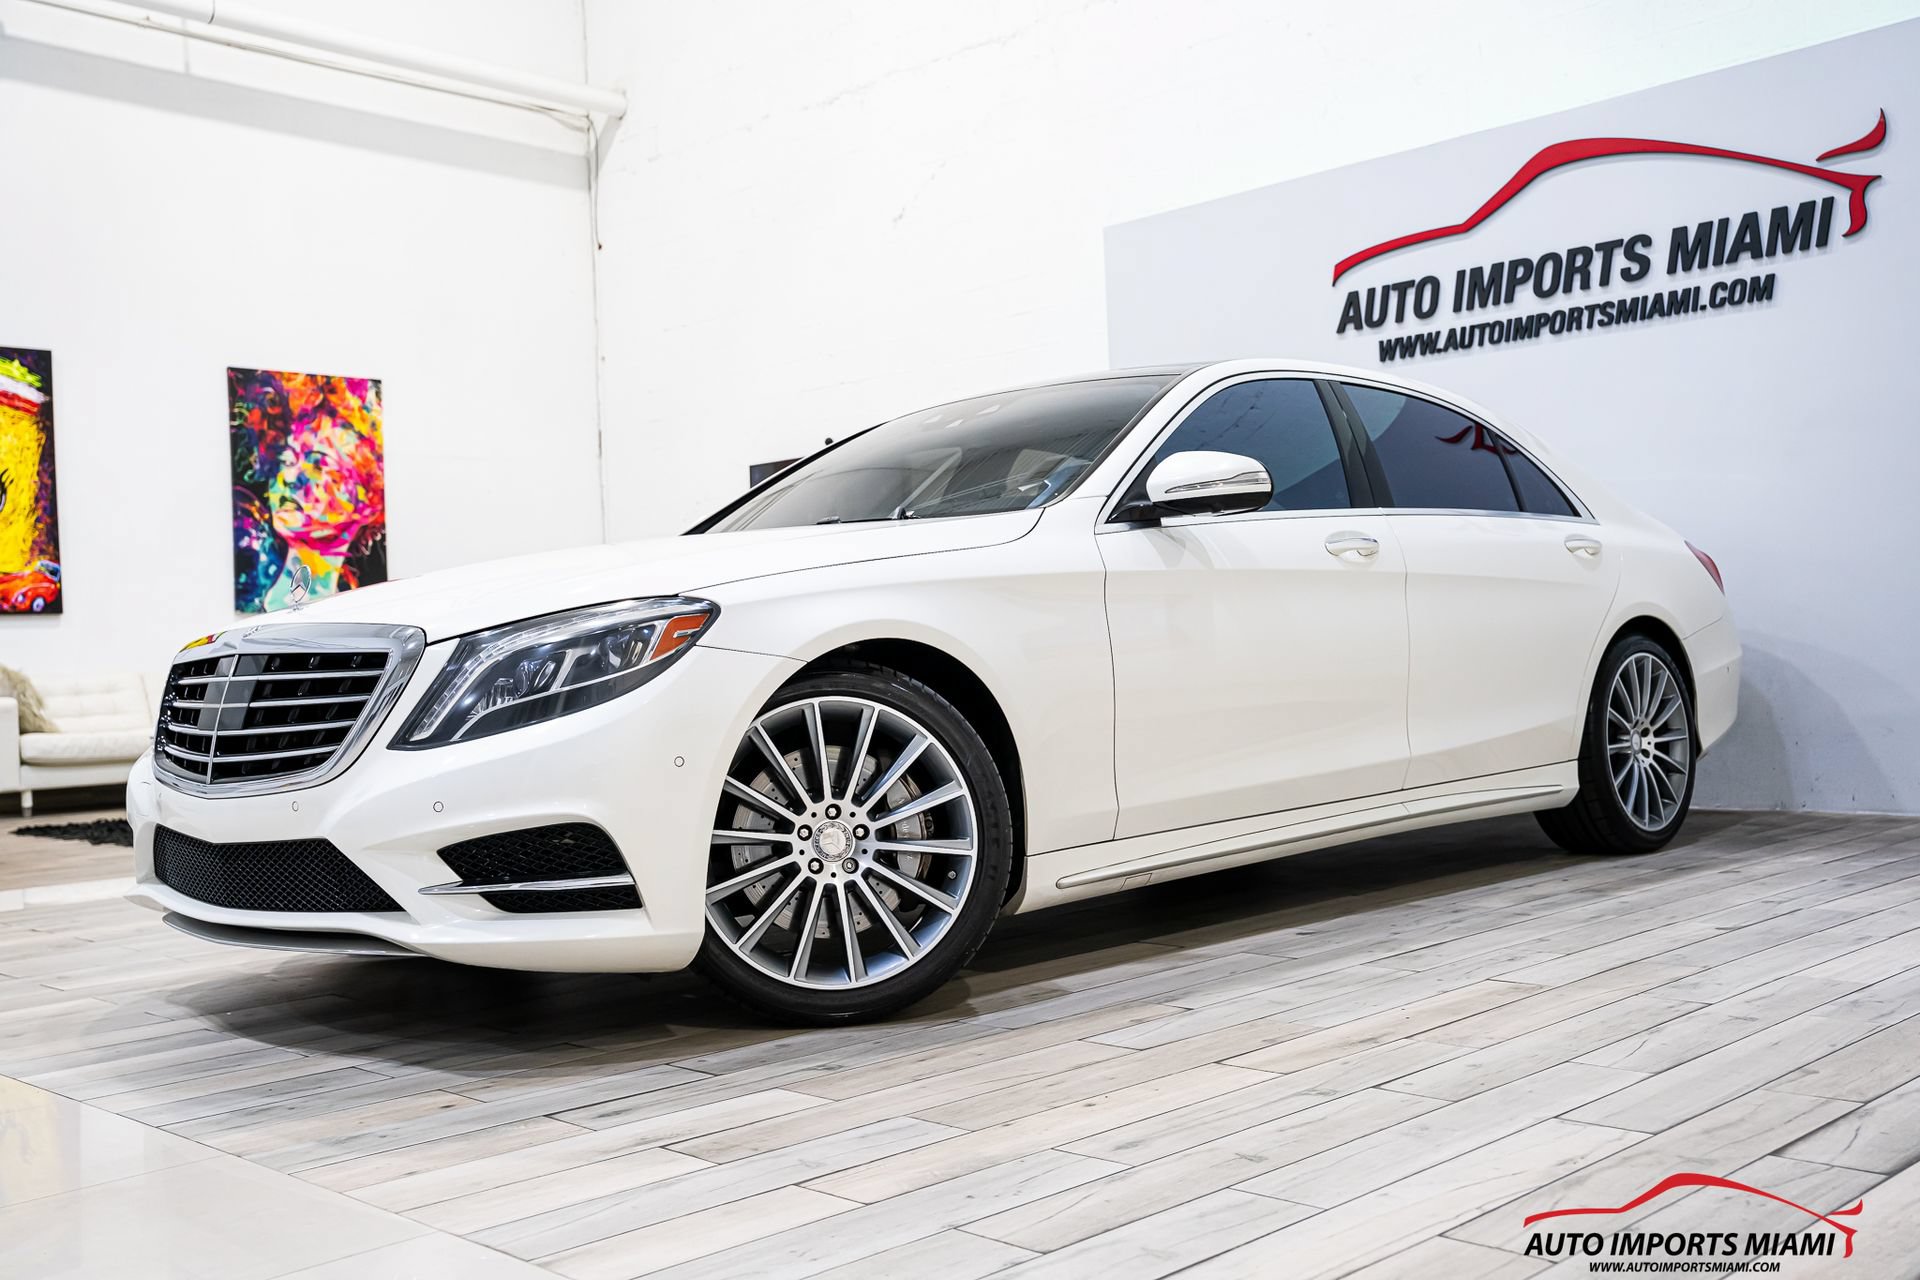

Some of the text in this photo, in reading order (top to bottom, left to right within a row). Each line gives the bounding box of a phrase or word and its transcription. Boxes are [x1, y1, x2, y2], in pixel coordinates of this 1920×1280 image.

[1336, 196, 1835, 334] AUTO IMPORTS MIAMI
[1378, 273, 1776, 363] WWW.AUTOIMPORTSMIAMI.COM
